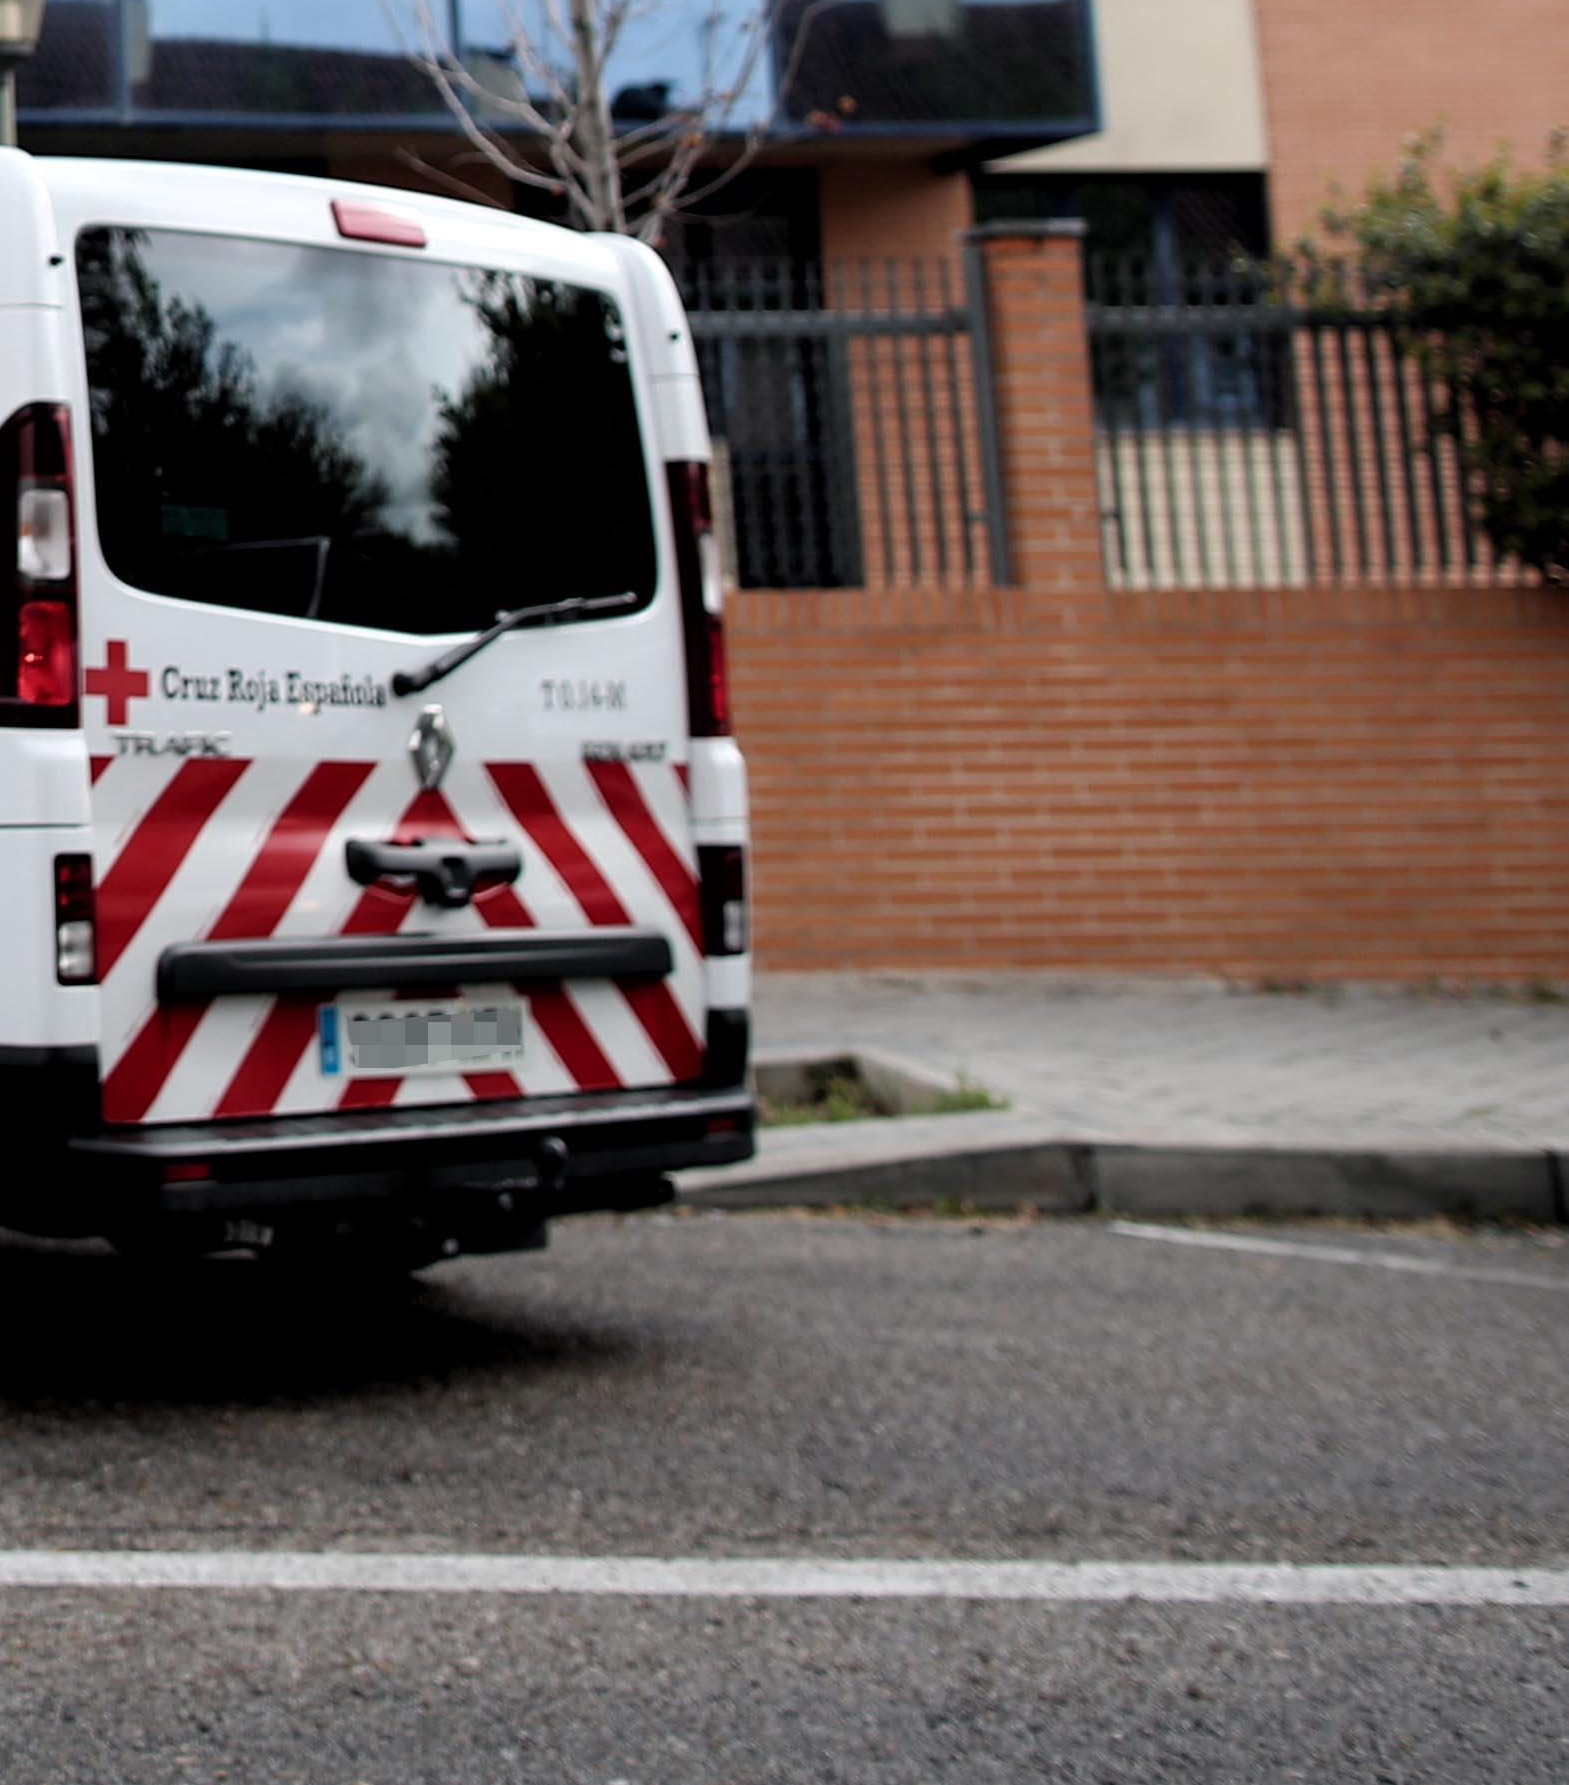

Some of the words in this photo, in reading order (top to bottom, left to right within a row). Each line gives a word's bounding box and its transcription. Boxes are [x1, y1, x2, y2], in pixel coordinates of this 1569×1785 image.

[162, 667, 220, 700] Cruz
[226, 669, 280, 711] Roja
[284, 672, 386, 716] Española
[113, 731, 233, 756] TRAFIC
